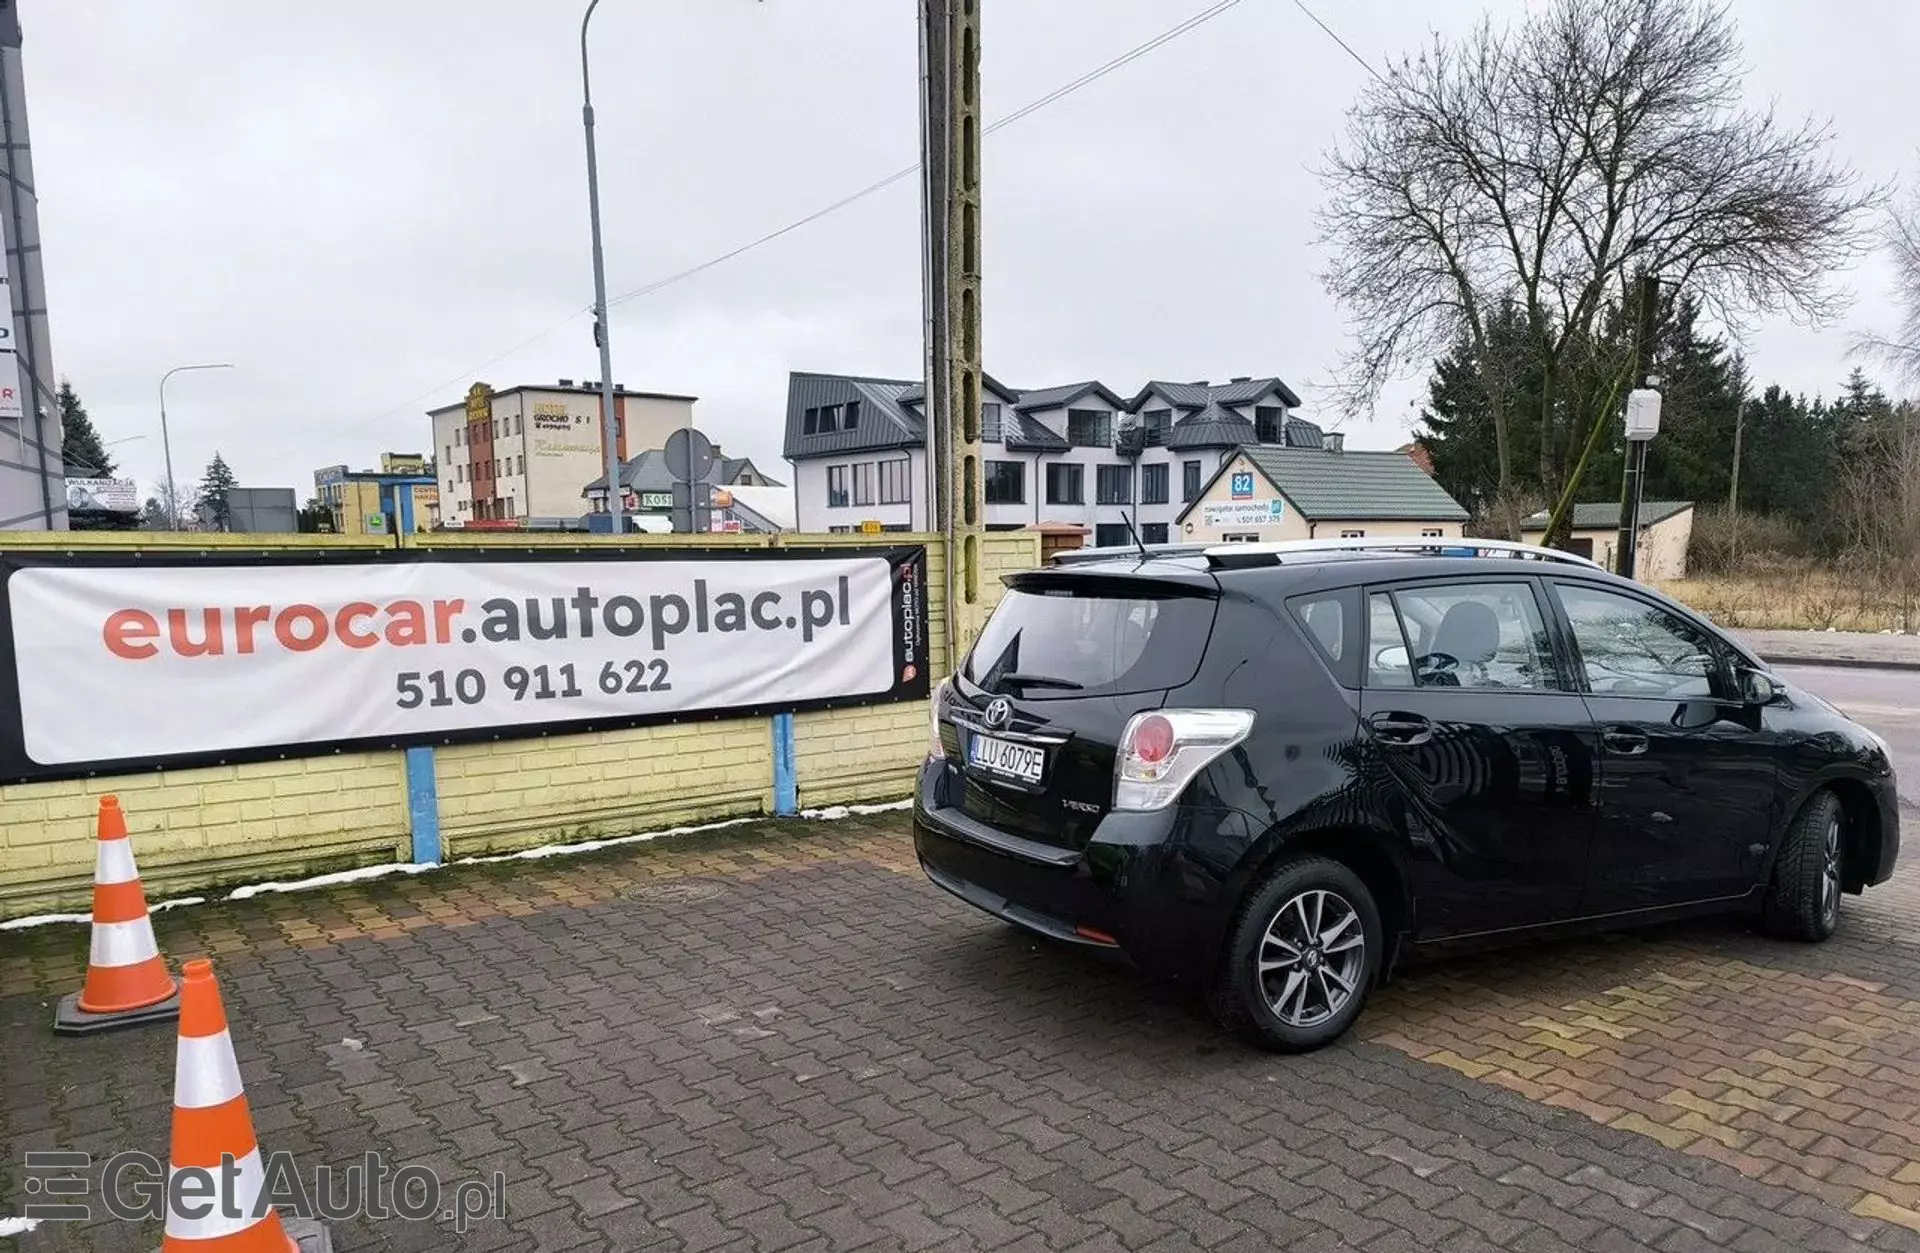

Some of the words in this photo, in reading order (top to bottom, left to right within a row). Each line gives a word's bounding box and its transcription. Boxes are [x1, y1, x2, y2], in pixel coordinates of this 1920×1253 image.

[1234, 475, 1250, 492] 82
[103, 575, 850, 660] eurocar.autoplac.pl
[900, 563, 914, 663] autoplac.pl
[396, 669, 486, 709] 510
[503, 663, 582, 701] 911
[599, 658, 672, 695] 622
